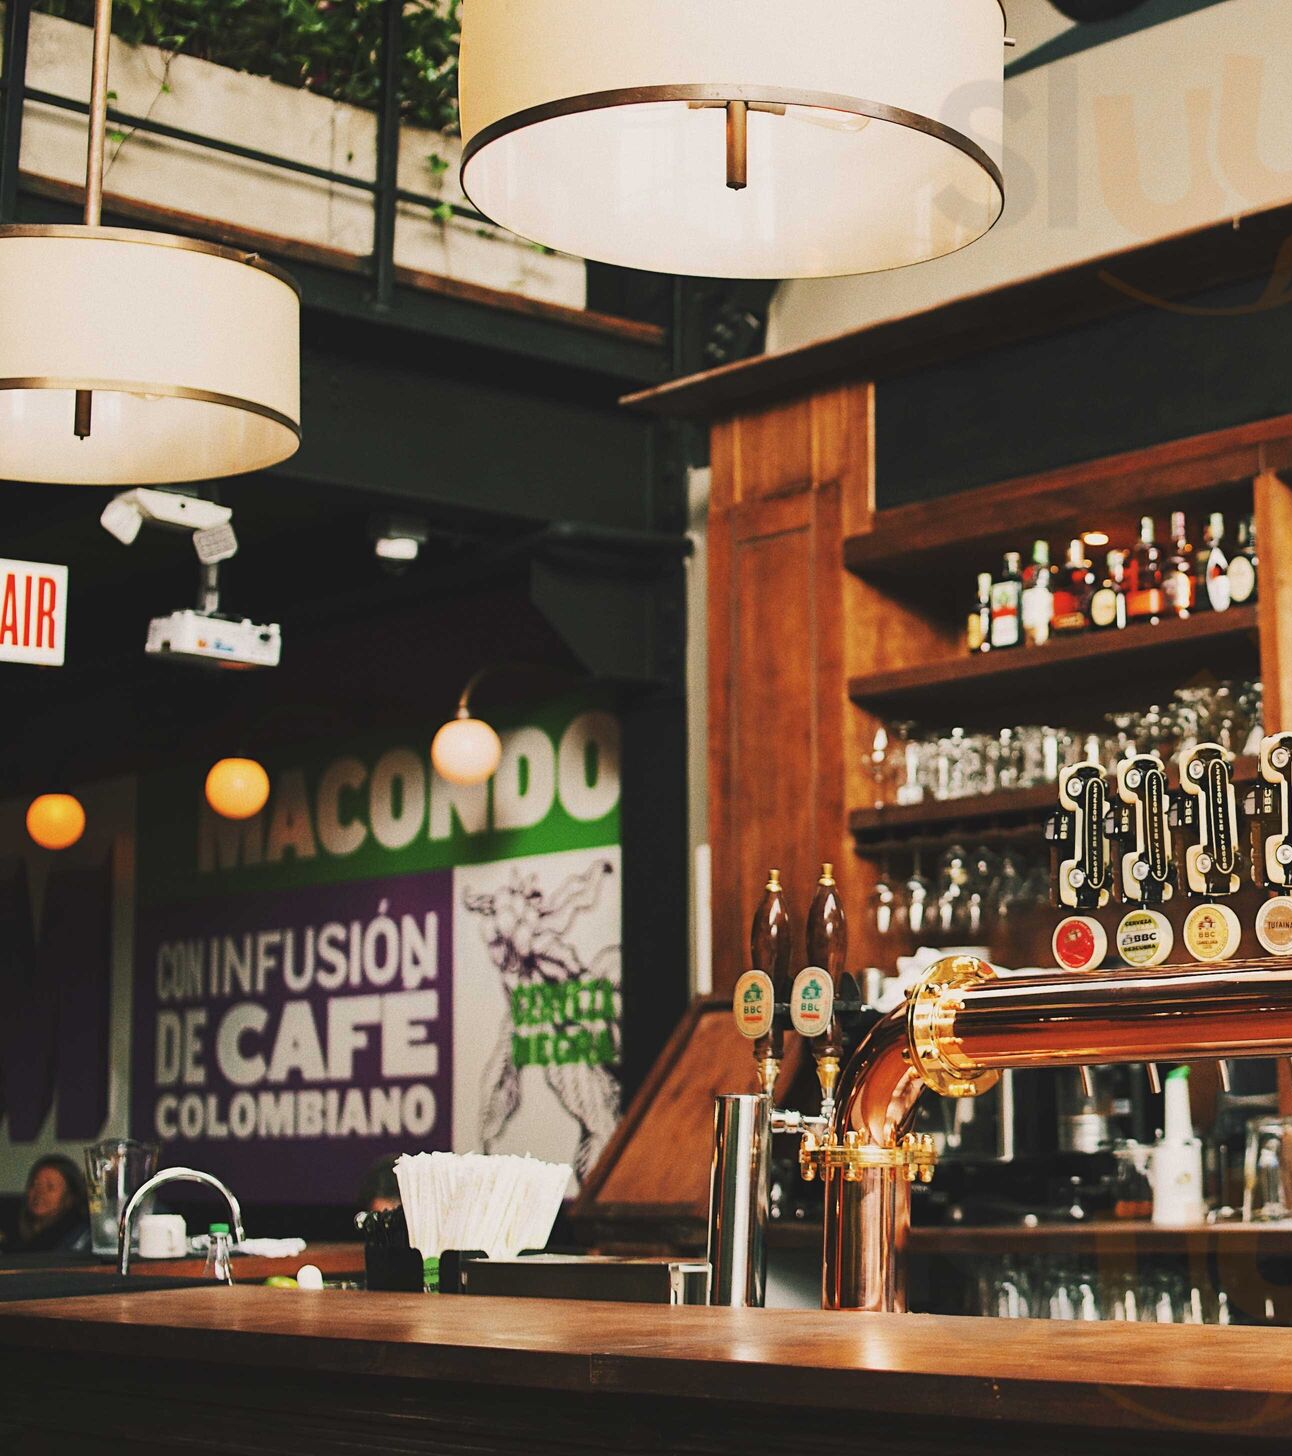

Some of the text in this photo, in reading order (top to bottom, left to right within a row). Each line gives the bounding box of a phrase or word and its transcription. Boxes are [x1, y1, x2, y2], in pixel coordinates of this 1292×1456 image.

[0, 573, 56, 649] AIR
[1264, 787, 1272, 813] BBC
[1060, 815, 1068, 839] BBC
[1121, 808, 1129, 832] BBC
[157, 898, 438, 1000] CON INFUSIÓN
[1134, 933, 1157, 942] BBC
[743, 1006, 761, 1014] BBC
[801, 1003, 820, 1012] BBC
[155, 1008, 207, 1086] DE
[155, 1083, 436, 1140] COLOMBIANO
